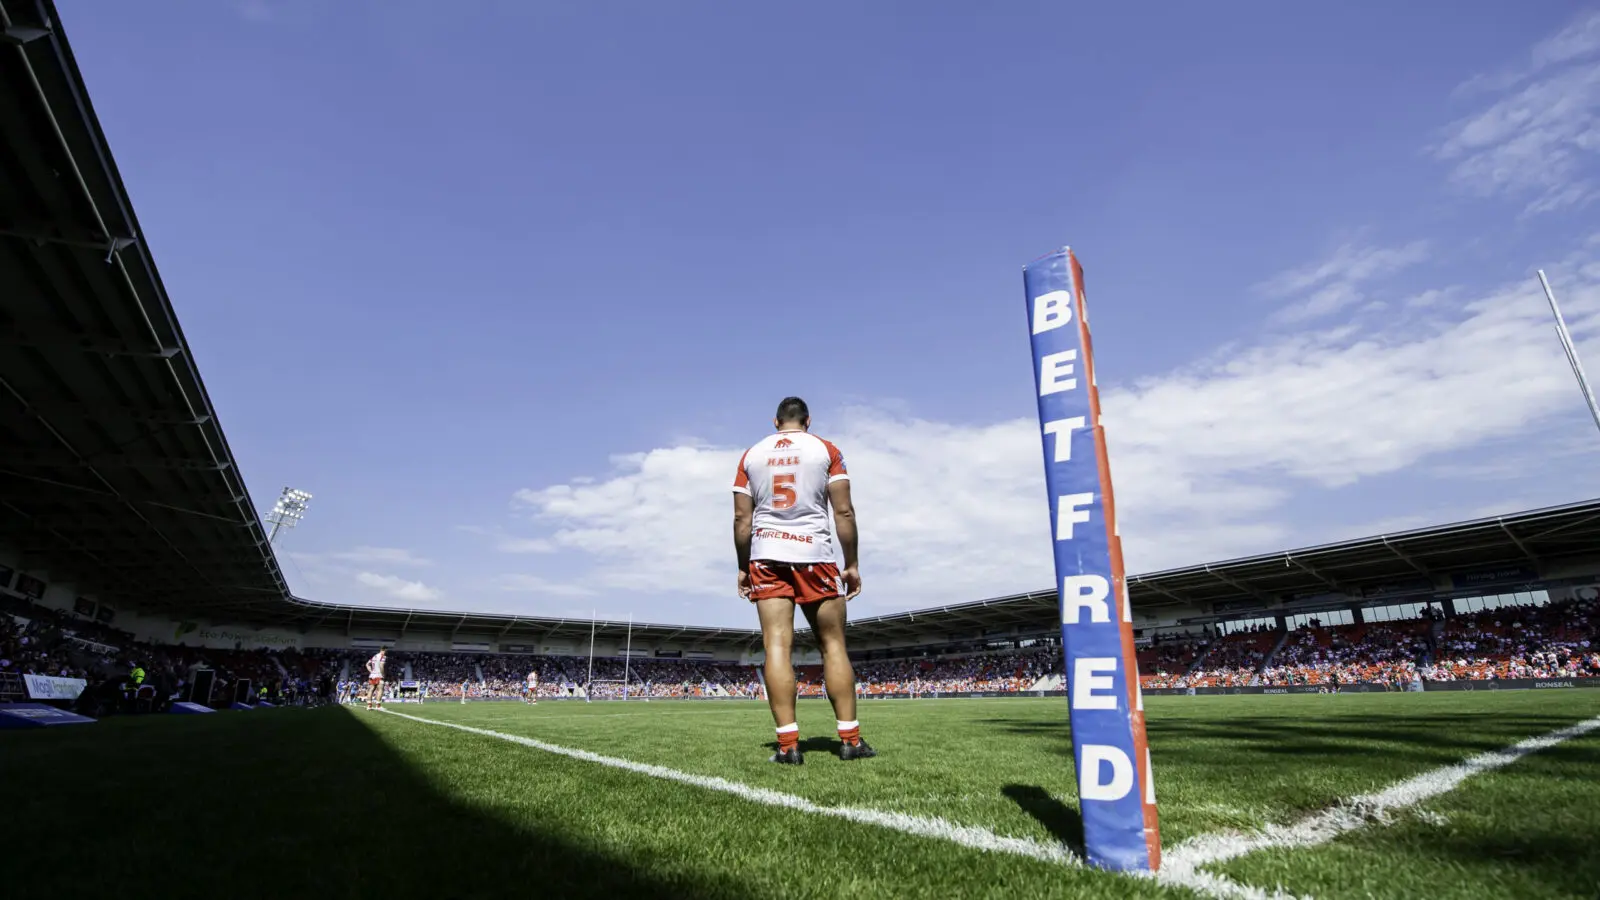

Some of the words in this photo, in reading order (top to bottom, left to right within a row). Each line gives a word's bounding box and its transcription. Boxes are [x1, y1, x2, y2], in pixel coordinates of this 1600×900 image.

[767, 455, 801, 467] HALL
[772, 472, 798, 511] 5
[1032, 289, 1134, 803] BETFRED
